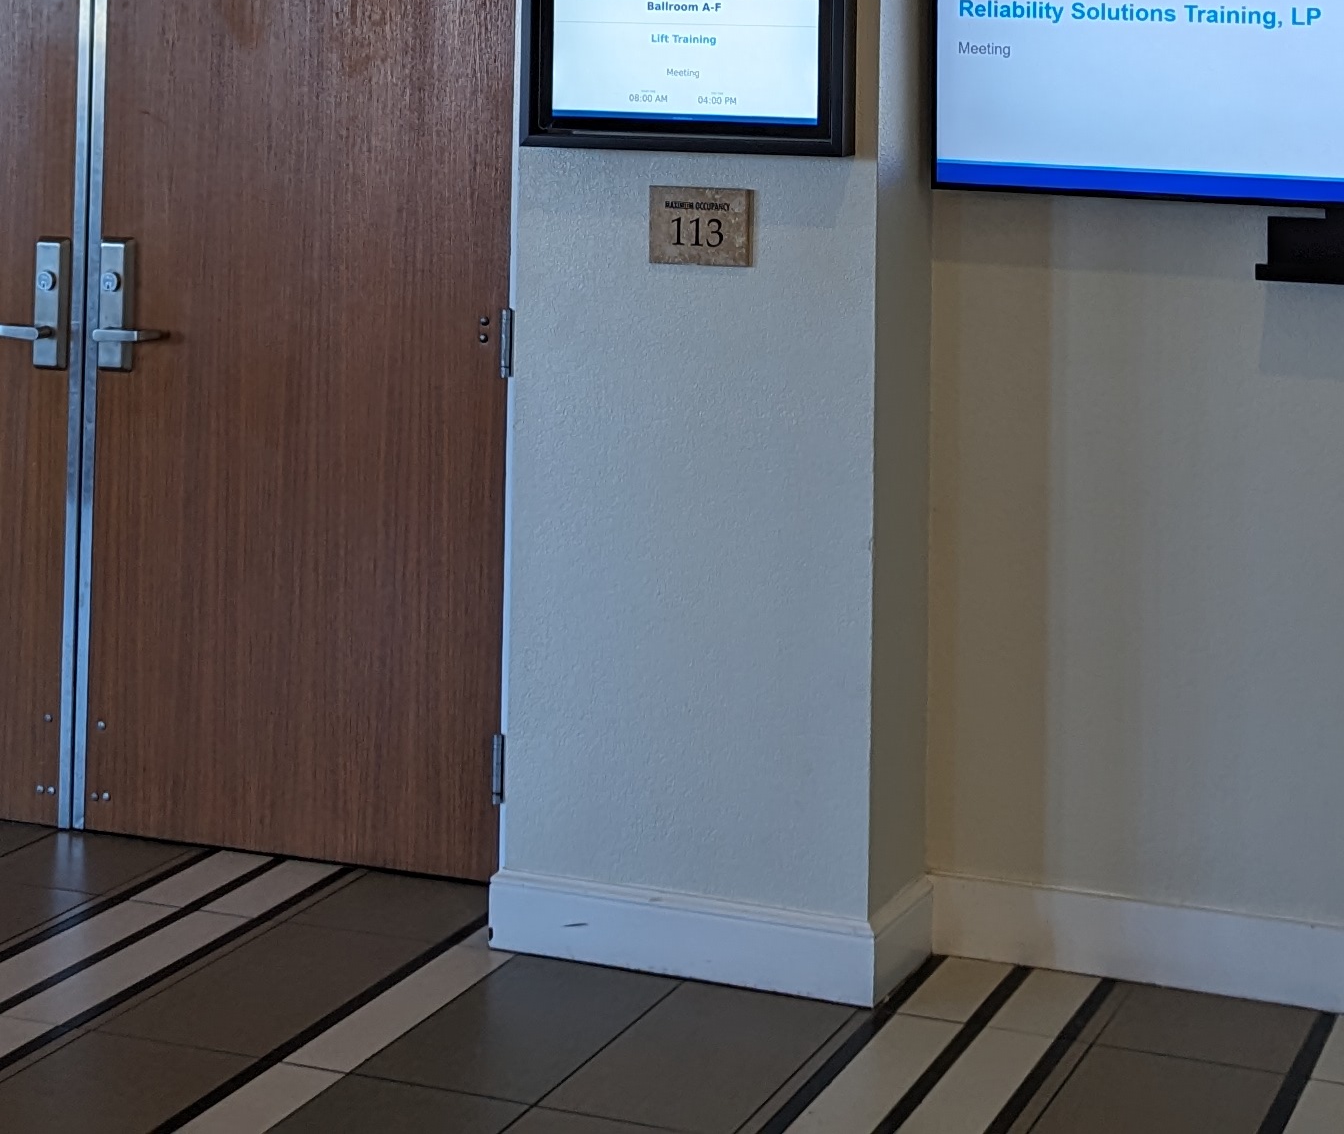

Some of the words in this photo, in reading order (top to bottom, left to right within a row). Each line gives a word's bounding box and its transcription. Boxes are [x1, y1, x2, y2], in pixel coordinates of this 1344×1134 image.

[647, 1, 699, 12] Ballroom
[702, 2, 722, 12] A-F
[959, 0, 1064, 24] Reliability
[1071, 2, 1177, 23] Solutions
[1184, 4, 1284, 29] Training,
[1291, 7, 1322, 26] LP
[651, 33, 669, 43] Lift
[672, 34, 717, 46] Training
[958, 41, 1011, 58] Meeting
[666, 68, 700, 79] Meeting
[629, 93, 653, 103] 08:00
[655, 94, 668, 103] AM
[697, 95, 722, 105] 04:00
[725, 97, 737, 105] PM
[695, 201, 731, 212] OCCUPANCY
[671, 216, 724, 248] 113
